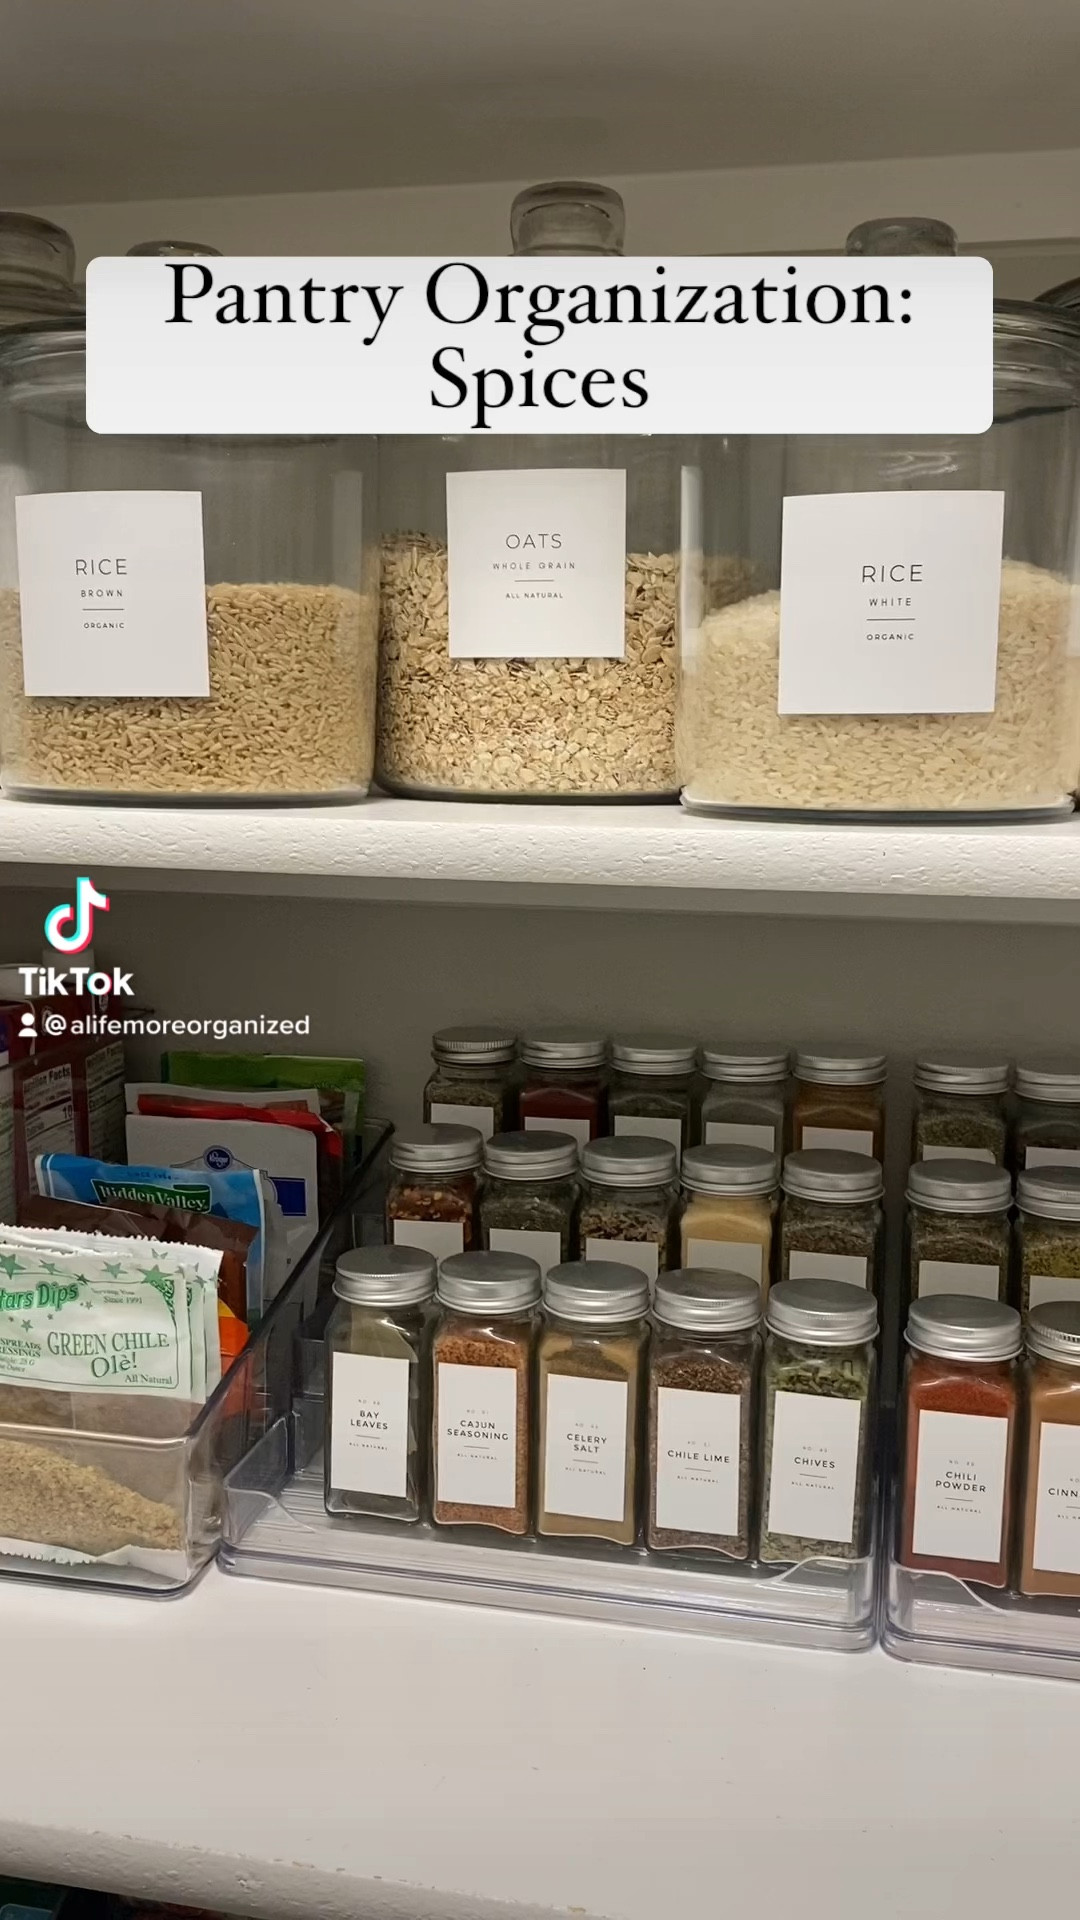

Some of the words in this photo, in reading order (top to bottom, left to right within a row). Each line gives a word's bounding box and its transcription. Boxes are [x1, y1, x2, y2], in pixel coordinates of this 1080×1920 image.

[505, 533, 562, 549] OATS
[75, 558, 128, 576] RICE
[492, 562, 531, 570] WHOLE
[538, 561, 576, 569] GRAIN
[862, 564, 923, 582] RICE
[80, 588, 123, 598] BROWN
[524, 591, 564, 599] NATURAL
[868, 597, 912, 607] WHITE
[83, 621, 125, 629] ORGANIC
[866, 632, 915, 641] ORGANIC
[99, 1185, 155, 1202] Hidden
[155, 1190, 206, 1211] Valley
[0, 1288, 34, 1310] tars
[36, 1281, 79, 1311] Dips
[47, 1331, 107, 1357] GREEN
[111, 1332, 170, 1351] CHILE
[0, 1346, 41, 1358] ESSINGS
[124, 1374, 138, 1384] All
[140, 1374, 173, 1385] Natural
[360, 1409, 380, 1419] BAY
[350, 1418, 388, 1430] LEAVES
[459, 1419, 496, 1430] CAJUN
[446, 1428, 509, 1441] SEASONING
[566, 1433, 608, 1445] CELERY
[573, 1444, 600, 1454] SALT
[667, 1449, 700, 1461] CHILE
[703, 1453, 730, 1464] LIME
[794, 1456, 836, 1469] CHIVES
[945, 1471, 977, 1482] CHILI
[935, 1480, 987, 1493] POWDER
[1048, 1487, 1080, 1498] CINN
